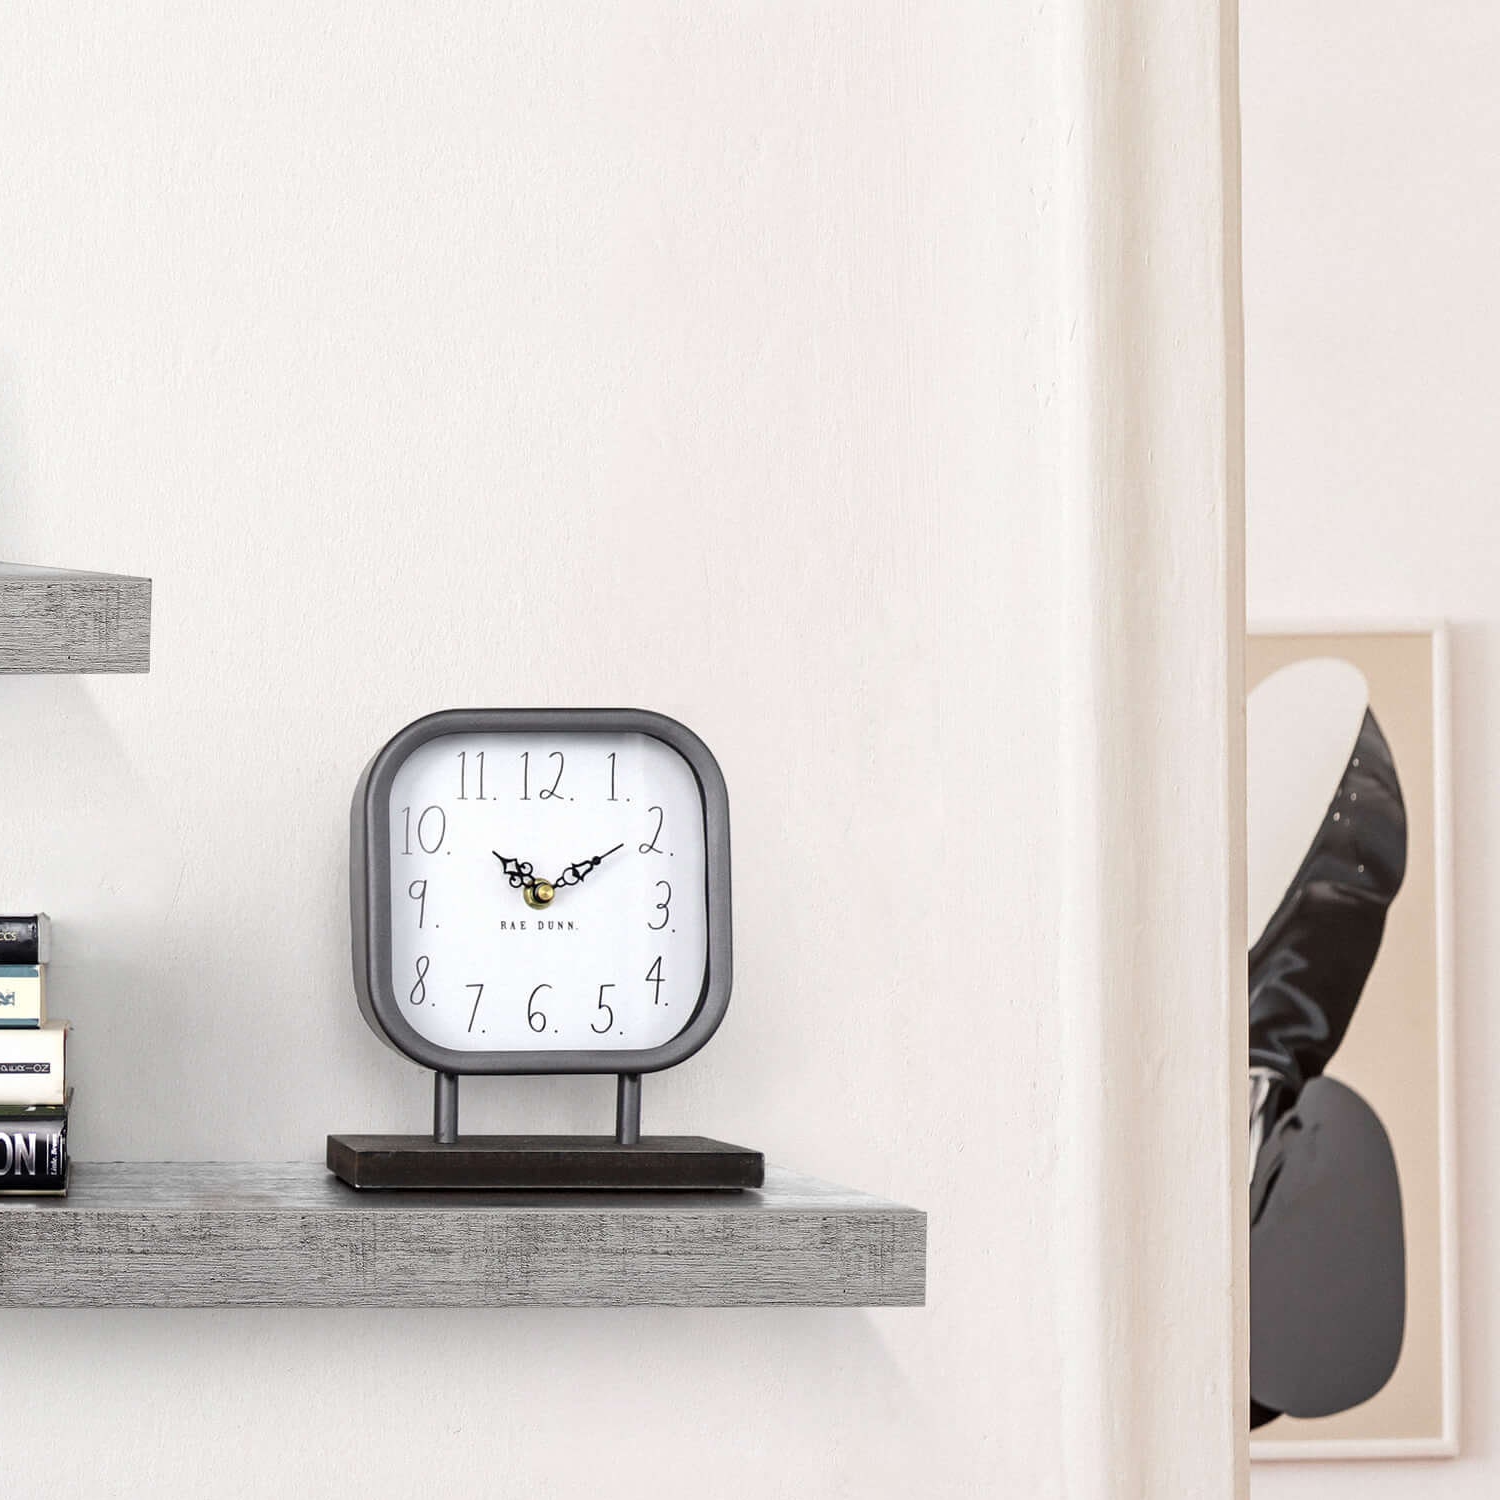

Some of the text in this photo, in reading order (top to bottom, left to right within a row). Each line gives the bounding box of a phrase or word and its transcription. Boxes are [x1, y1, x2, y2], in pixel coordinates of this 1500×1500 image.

[456, 751, 498, 801] 11.
[519, 751, 575, 801] 12.
[606, 752, 631, 802] 1.
[400, 805, 452, 855] 10.
[638, 806, 675, 857] 2.
[408, 880, 440, 929] 9.
[500, 920, 579, 930] RAE DUNN.
[647, 880, 676, 933] 3.
[409, 955, 436, 1007] 8.
[644, 955, 669, 1007] 4.
[465, 983, 486, 1034] 7.
[527, 983, 559, 1034] 6.
[590, 983, 624, 1035] 5.
